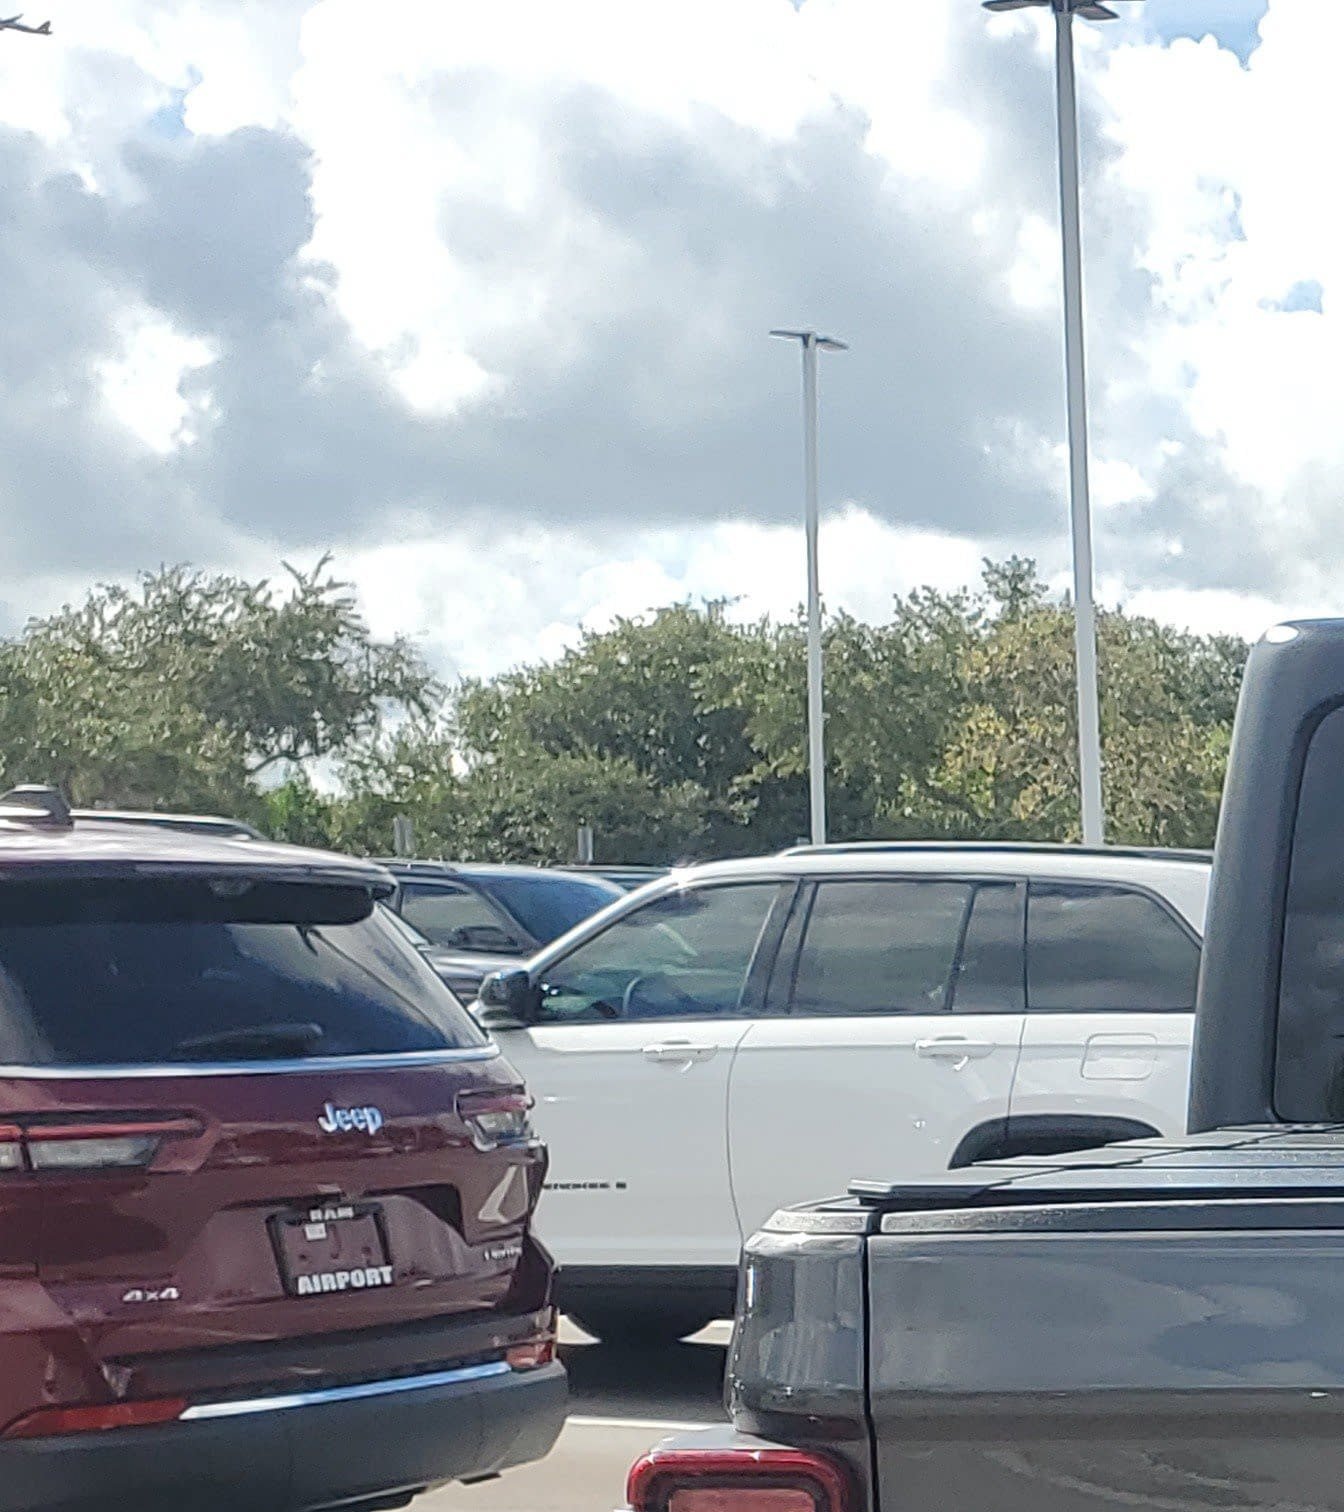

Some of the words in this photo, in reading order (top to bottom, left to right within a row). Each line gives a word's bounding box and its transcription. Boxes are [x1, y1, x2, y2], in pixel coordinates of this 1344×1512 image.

[317, 1103, 383, 1136] Jeep
[122, 1287, 179, 1302] 4x4
[297, 1265, 393, 1295] AIRPORT
